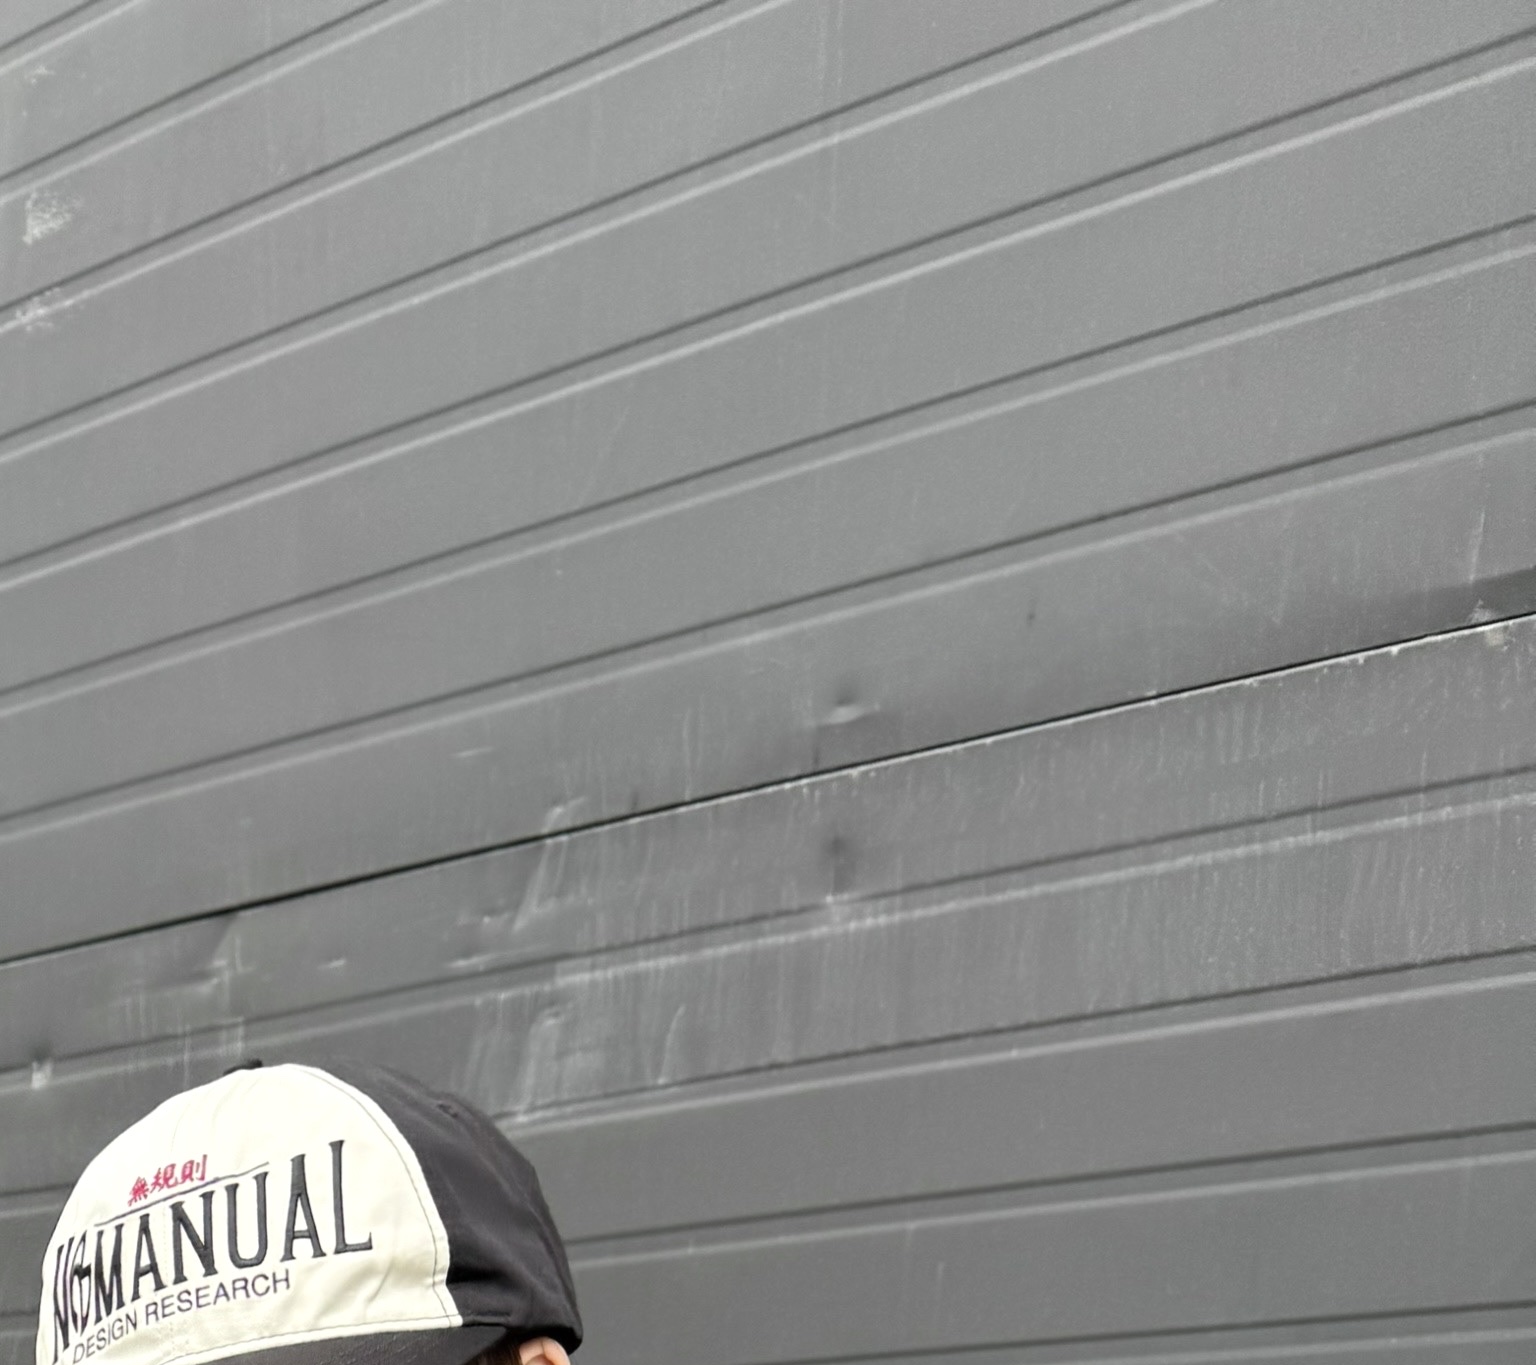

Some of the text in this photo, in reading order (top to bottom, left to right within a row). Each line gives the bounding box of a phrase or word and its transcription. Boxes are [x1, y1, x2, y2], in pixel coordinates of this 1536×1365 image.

[127, 1154, 208, 1206] 無規則
[72, 1268, 291, 1364] DESIGN RESEARCH
